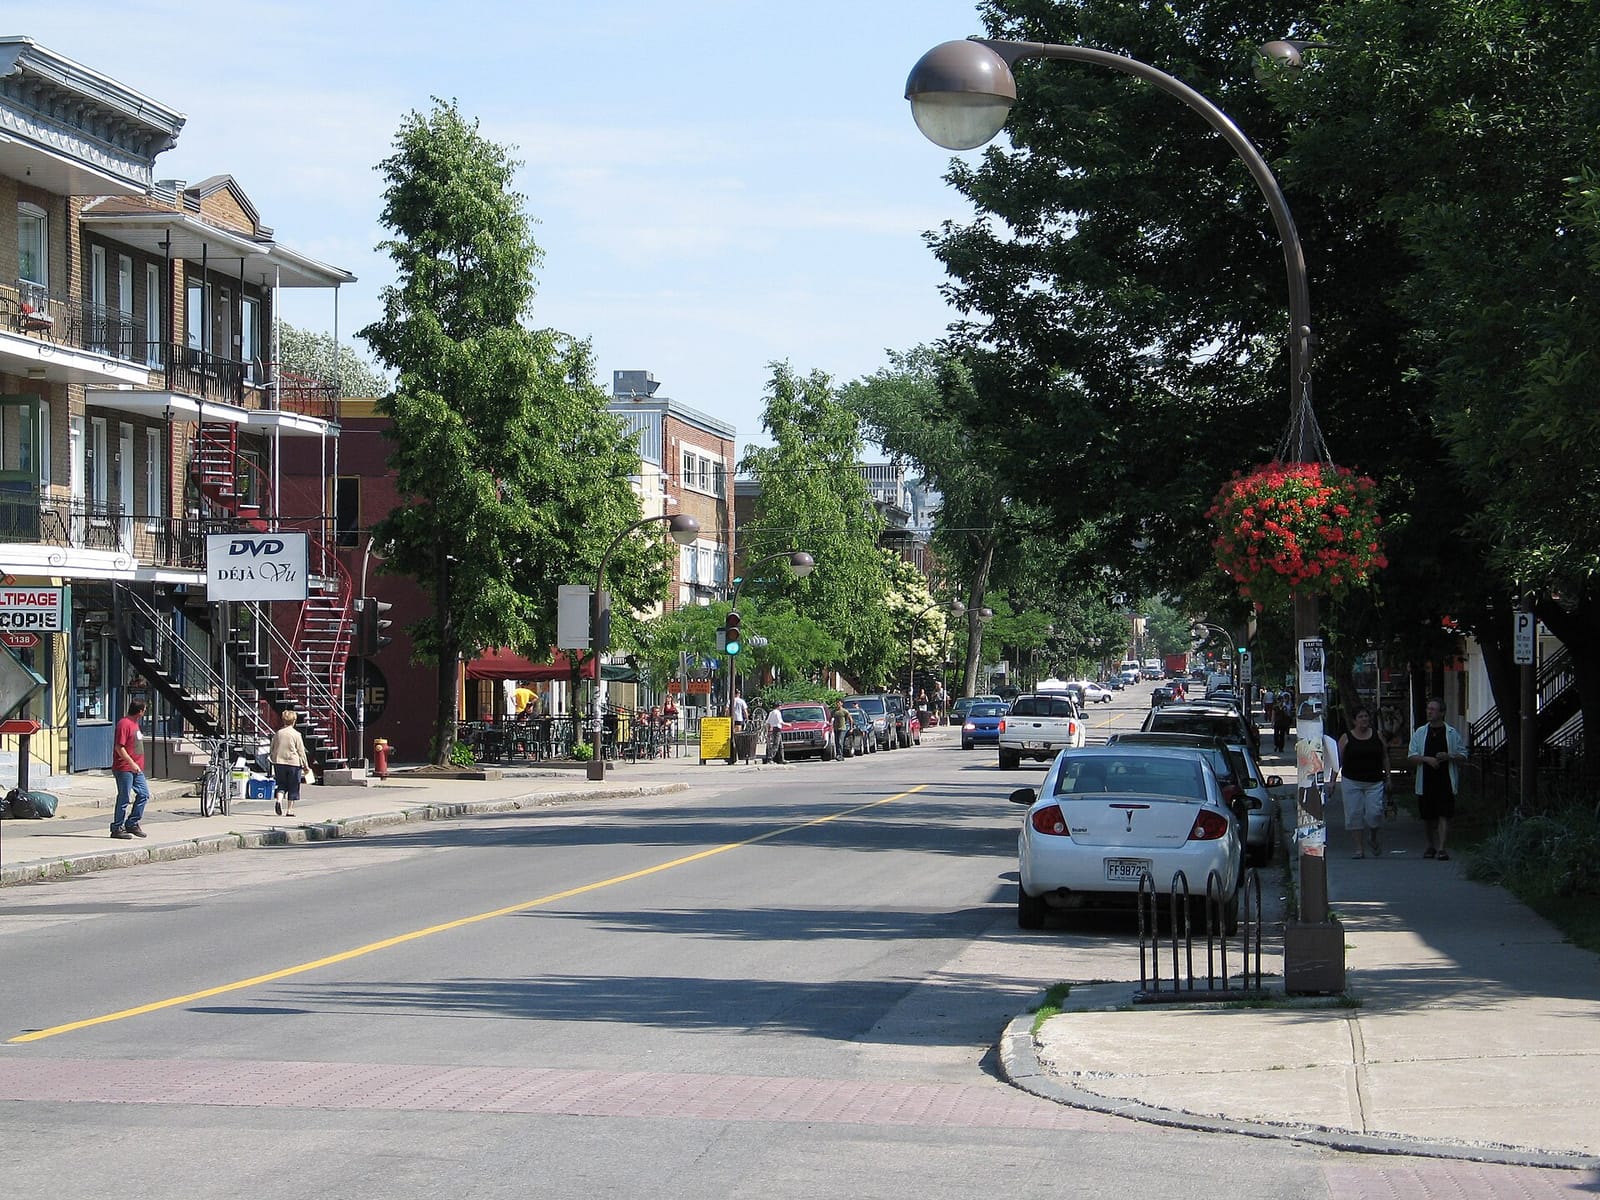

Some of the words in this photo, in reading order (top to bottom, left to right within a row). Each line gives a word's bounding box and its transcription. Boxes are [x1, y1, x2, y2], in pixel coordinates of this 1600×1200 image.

[229, 540, 284, 557] DVD
[218, 566, 255, 581] DÉJÀ
[259, 561, 297, 582] Vu
